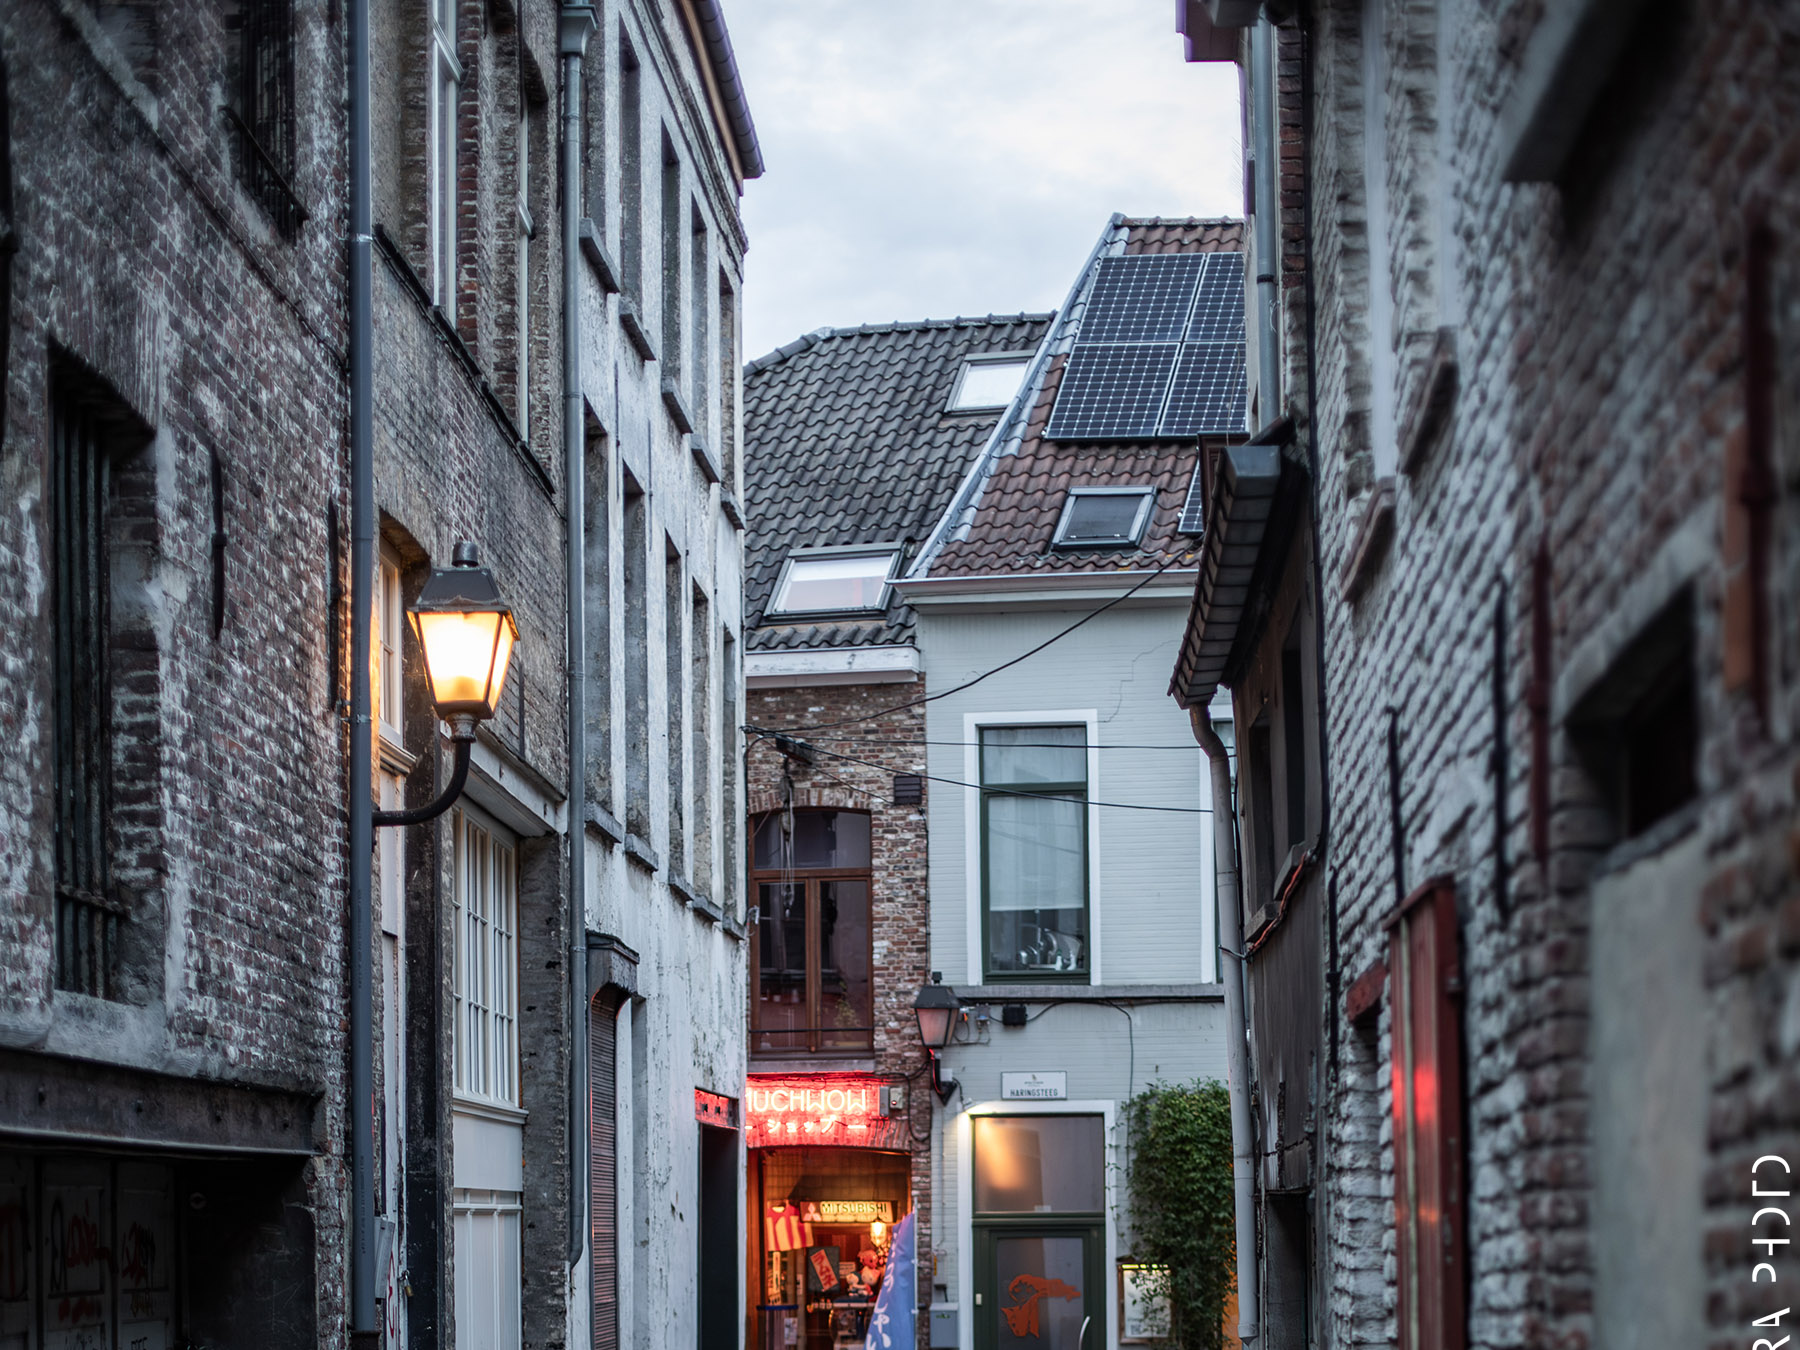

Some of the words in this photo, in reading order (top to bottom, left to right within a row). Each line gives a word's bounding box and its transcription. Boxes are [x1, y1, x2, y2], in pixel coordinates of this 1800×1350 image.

[1010, 1088, 1058, 1097] HARINGSTEEG
[767, 1115, 837, 1133] ショップ
[822, 1203, 887, 1213] MITSUBISHI
